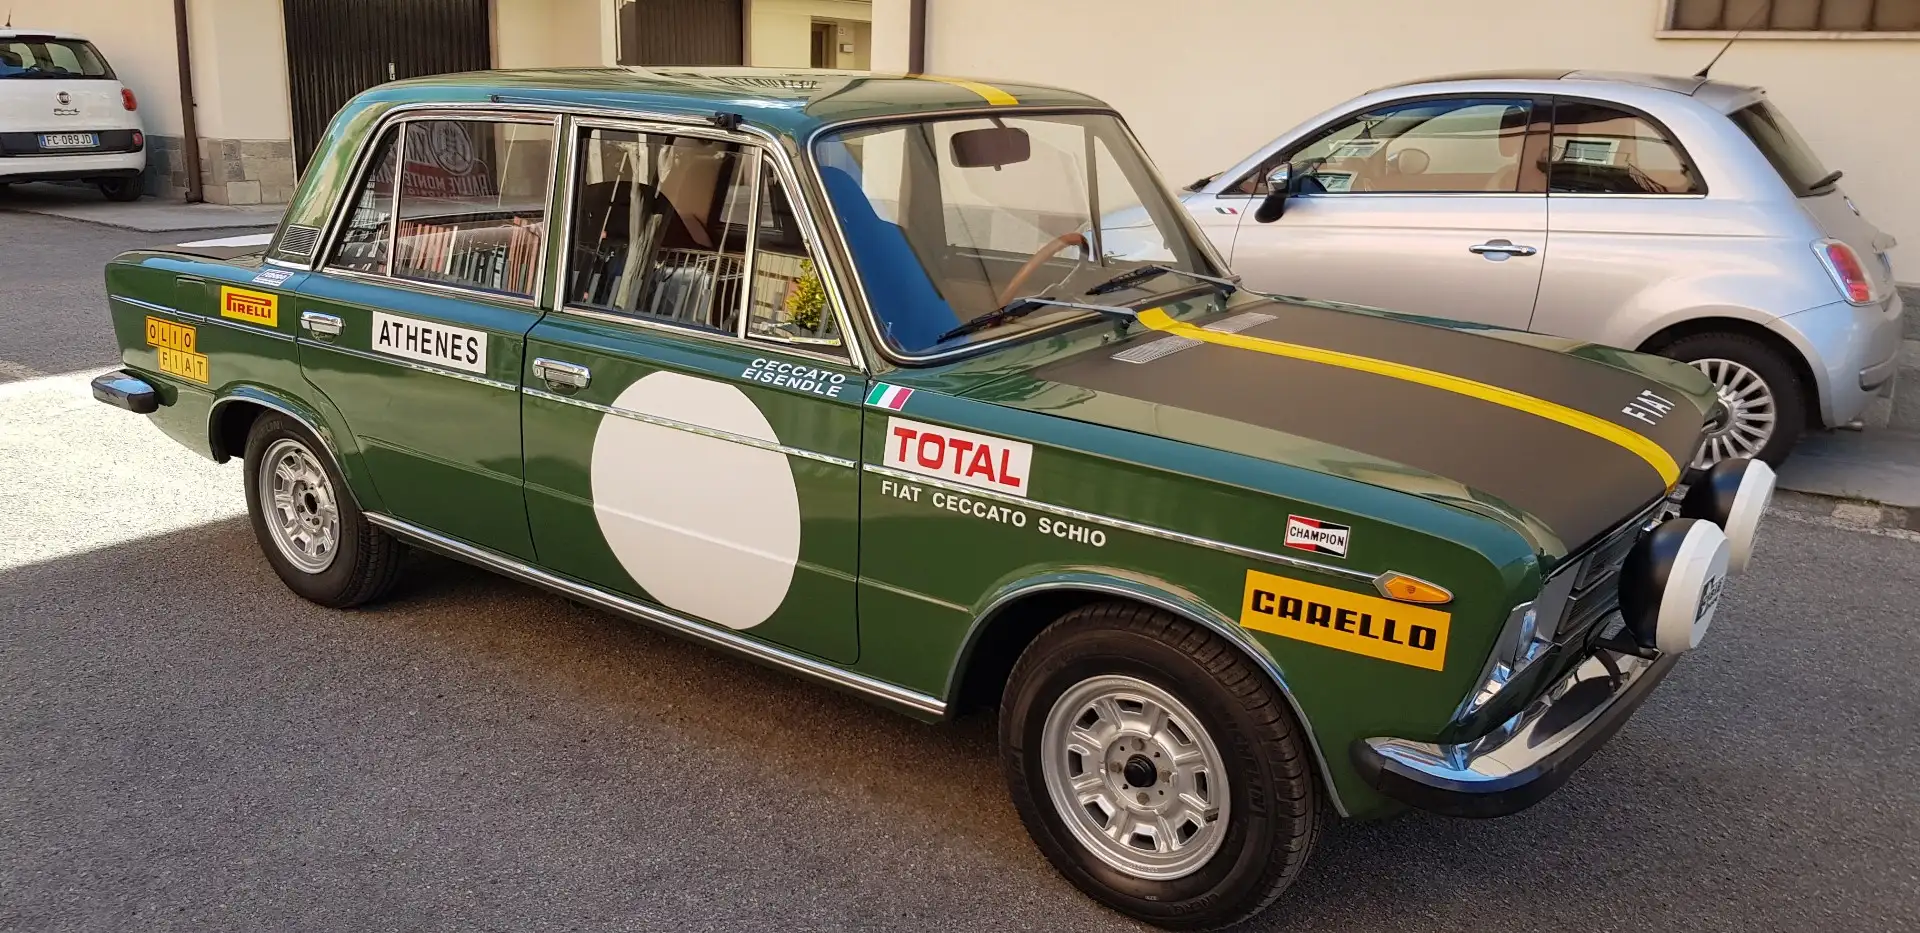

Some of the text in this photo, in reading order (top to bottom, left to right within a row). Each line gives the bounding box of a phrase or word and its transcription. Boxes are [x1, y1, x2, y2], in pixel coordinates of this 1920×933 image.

[45, 134, 92, 145] FC 089JD
[226, 292, 272, 319] PIRELLI
[149, 324, 192, 348] OLIO
[379, 320, 479, 365] ATHENES
[162, 351, 204, 373] FIAT
[751, 358, 846, 384] CECCATO
[741, 367, 842, 398] EISENDLE
[1621, 389, 1676, 426] FIAT
[893, 426, 1021, 488] TOTAL
[881, 480, 1107, 548] FIAT CECCATO SCHIO
[1289, 526, 1345, 547] CHAMPION
[1251, 589, 1437, 651] CARELLO
